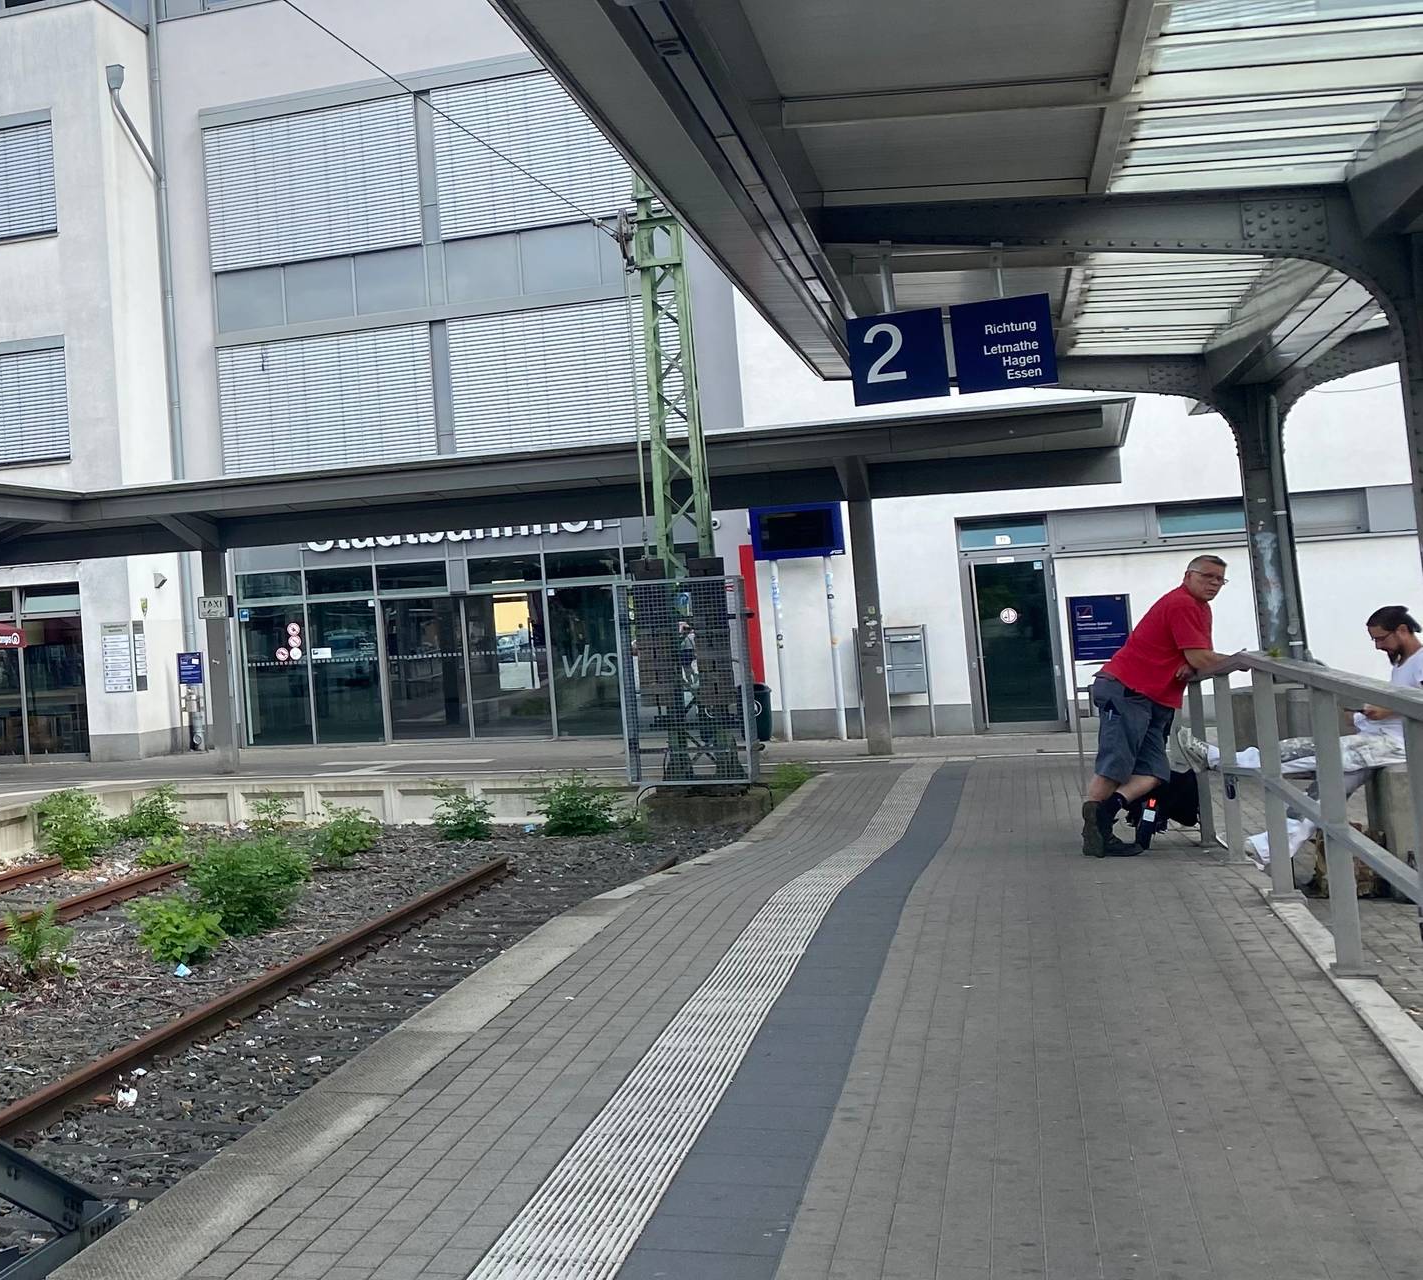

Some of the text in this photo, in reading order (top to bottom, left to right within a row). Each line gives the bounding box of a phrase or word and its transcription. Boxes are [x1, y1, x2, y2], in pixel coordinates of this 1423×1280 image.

[984, 320, 1037, 335] Richtung
[863, 323, 908, 384] 2
[983, 339, 1039, 355] Letmathe
[1002, 353, 1041, 367] Hagen
[1006, 366, 1043, 379] Essen
[202, 600, 223, 609] TAXI
[562, 644, 617, 678] vhs
